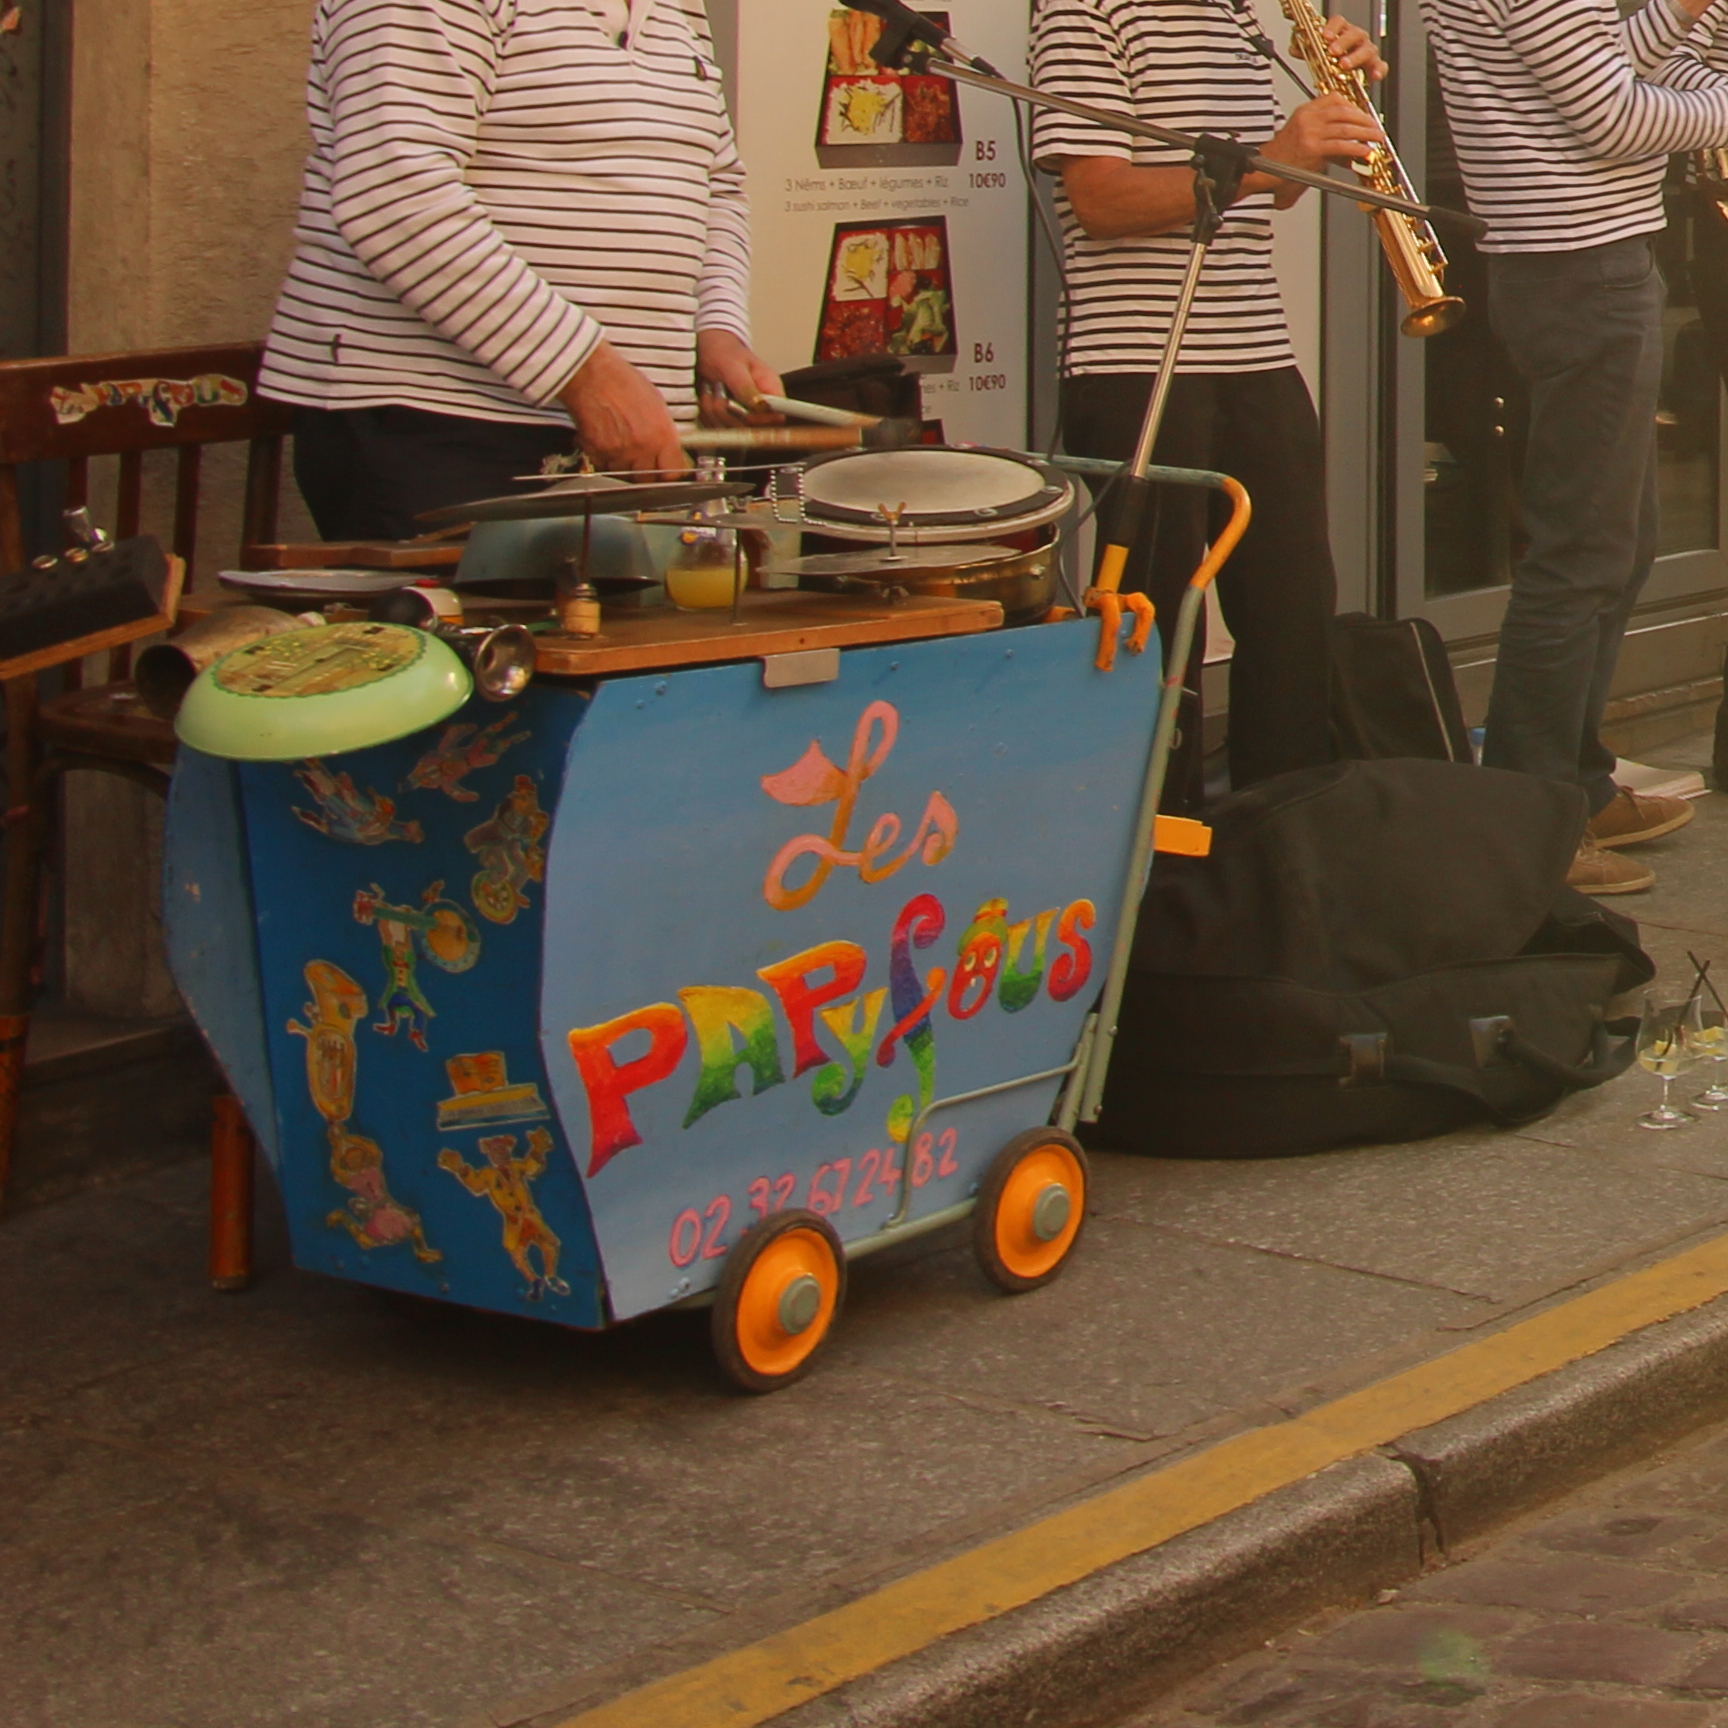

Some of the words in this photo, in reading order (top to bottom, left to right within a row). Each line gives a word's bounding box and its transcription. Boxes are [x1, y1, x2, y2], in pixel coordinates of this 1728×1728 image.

[975, 140, 996, 161] B5
[785, 179, 792, 192] 3
[969, 172, 1006, 189] 10€90
[973, 342, 994, 363] B6
[969, 374, 1006, 391] 10€90
[761, 700, 958, 911] Les
